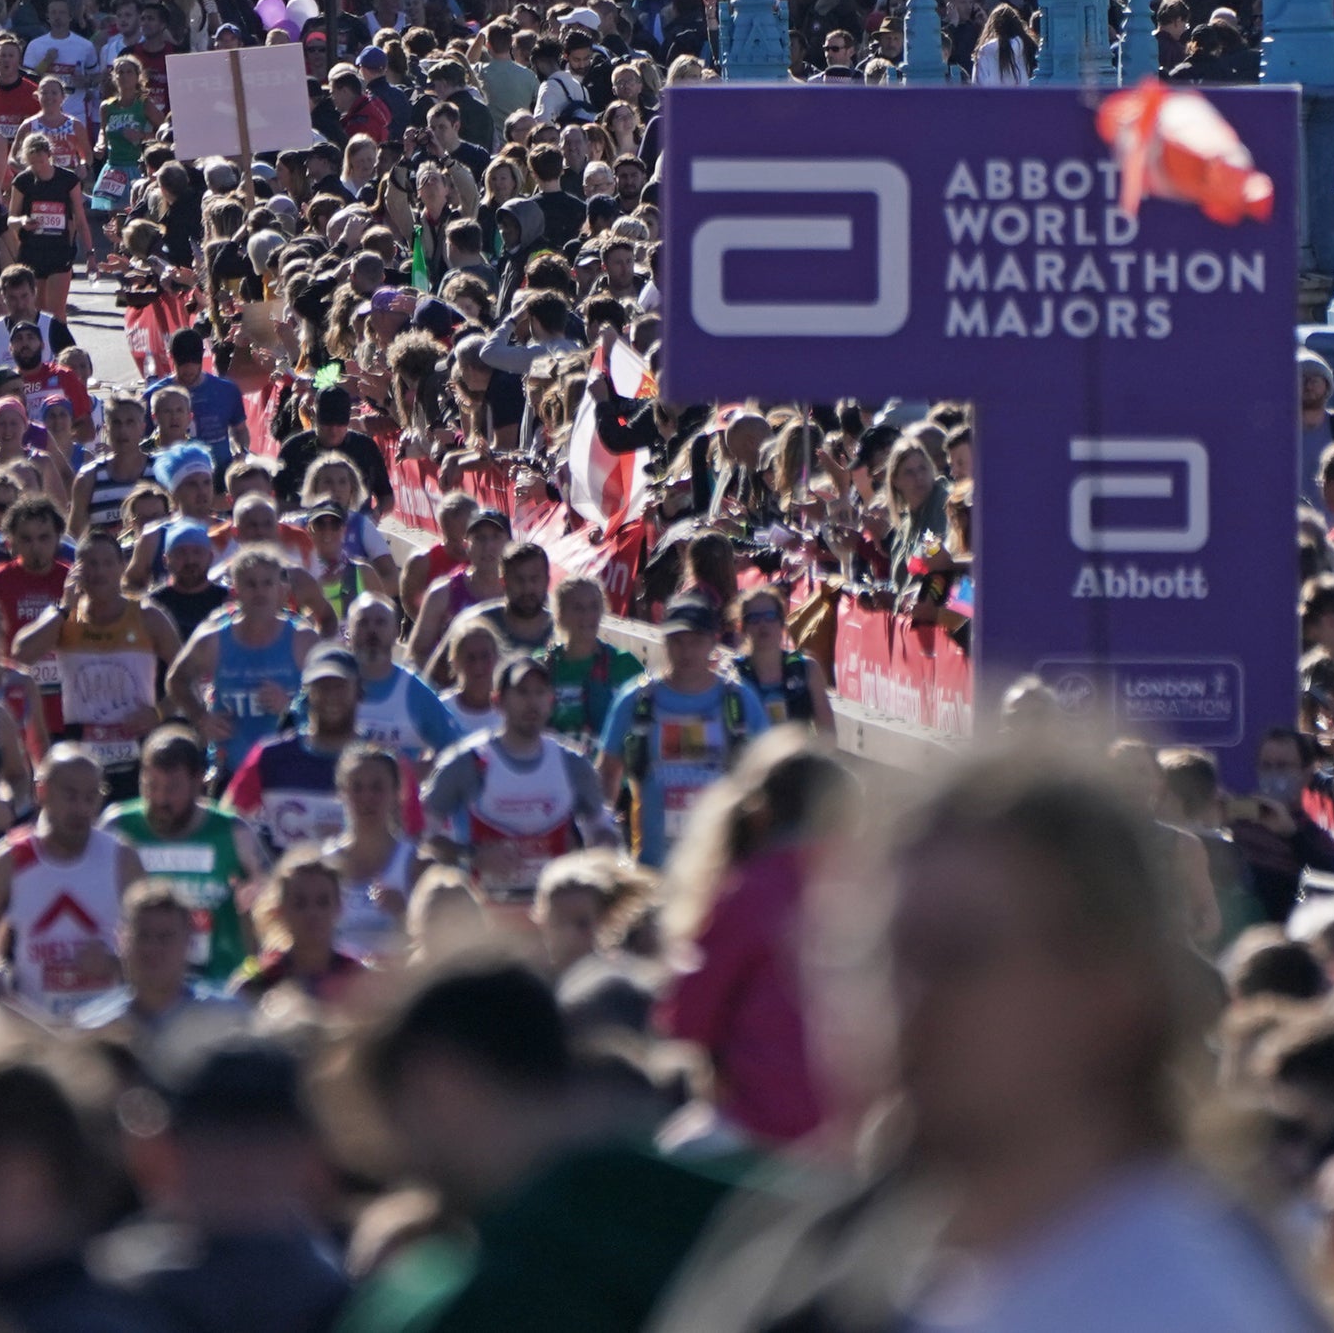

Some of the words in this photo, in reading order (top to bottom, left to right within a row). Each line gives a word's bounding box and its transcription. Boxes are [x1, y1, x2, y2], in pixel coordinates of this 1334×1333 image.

[944, 161, 1149, 200] ABBOT
[944, 205, 1139, 245] WORLD
[944, 250, 1266, 293] MARATHON
[944, 296, 1173, 339] MAJORS
[1072, 565, 1209, 599] Abbott
[1126, 679, 1206, 697] LONDON
[1126, 698, 1233, 716] MARATHON
